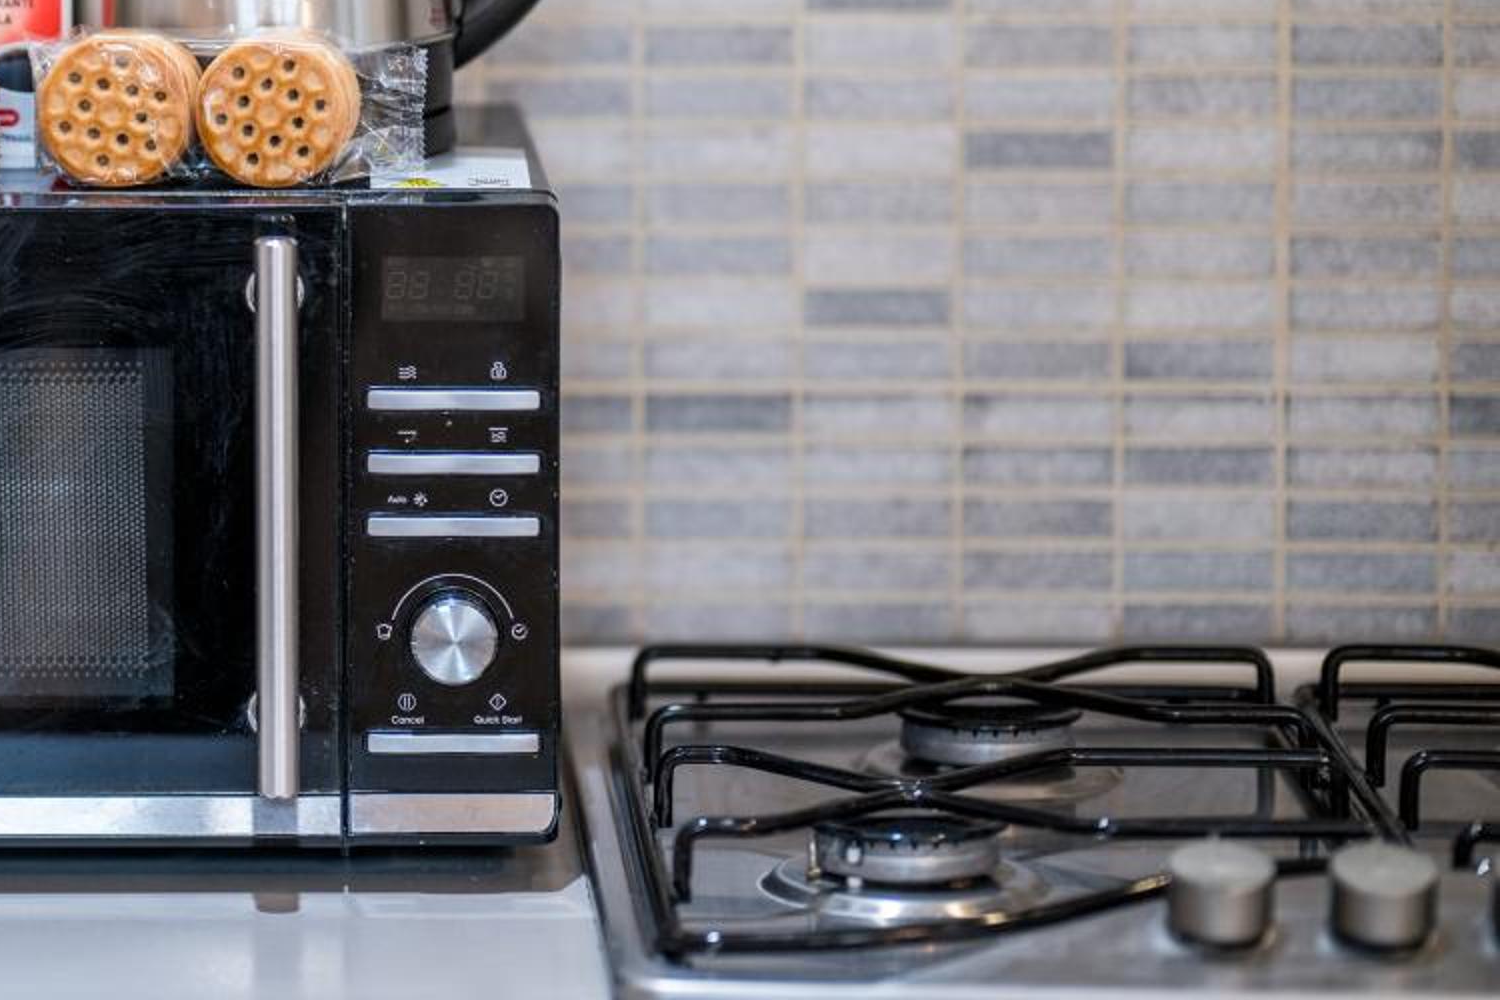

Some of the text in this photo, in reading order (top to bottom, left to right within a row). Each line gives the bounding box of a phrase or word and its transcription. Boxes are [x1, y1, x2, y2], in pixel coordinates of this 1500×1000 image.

[391, 715, 425, 725] Cancel
[473, 715, 523, 726] Quick Start
